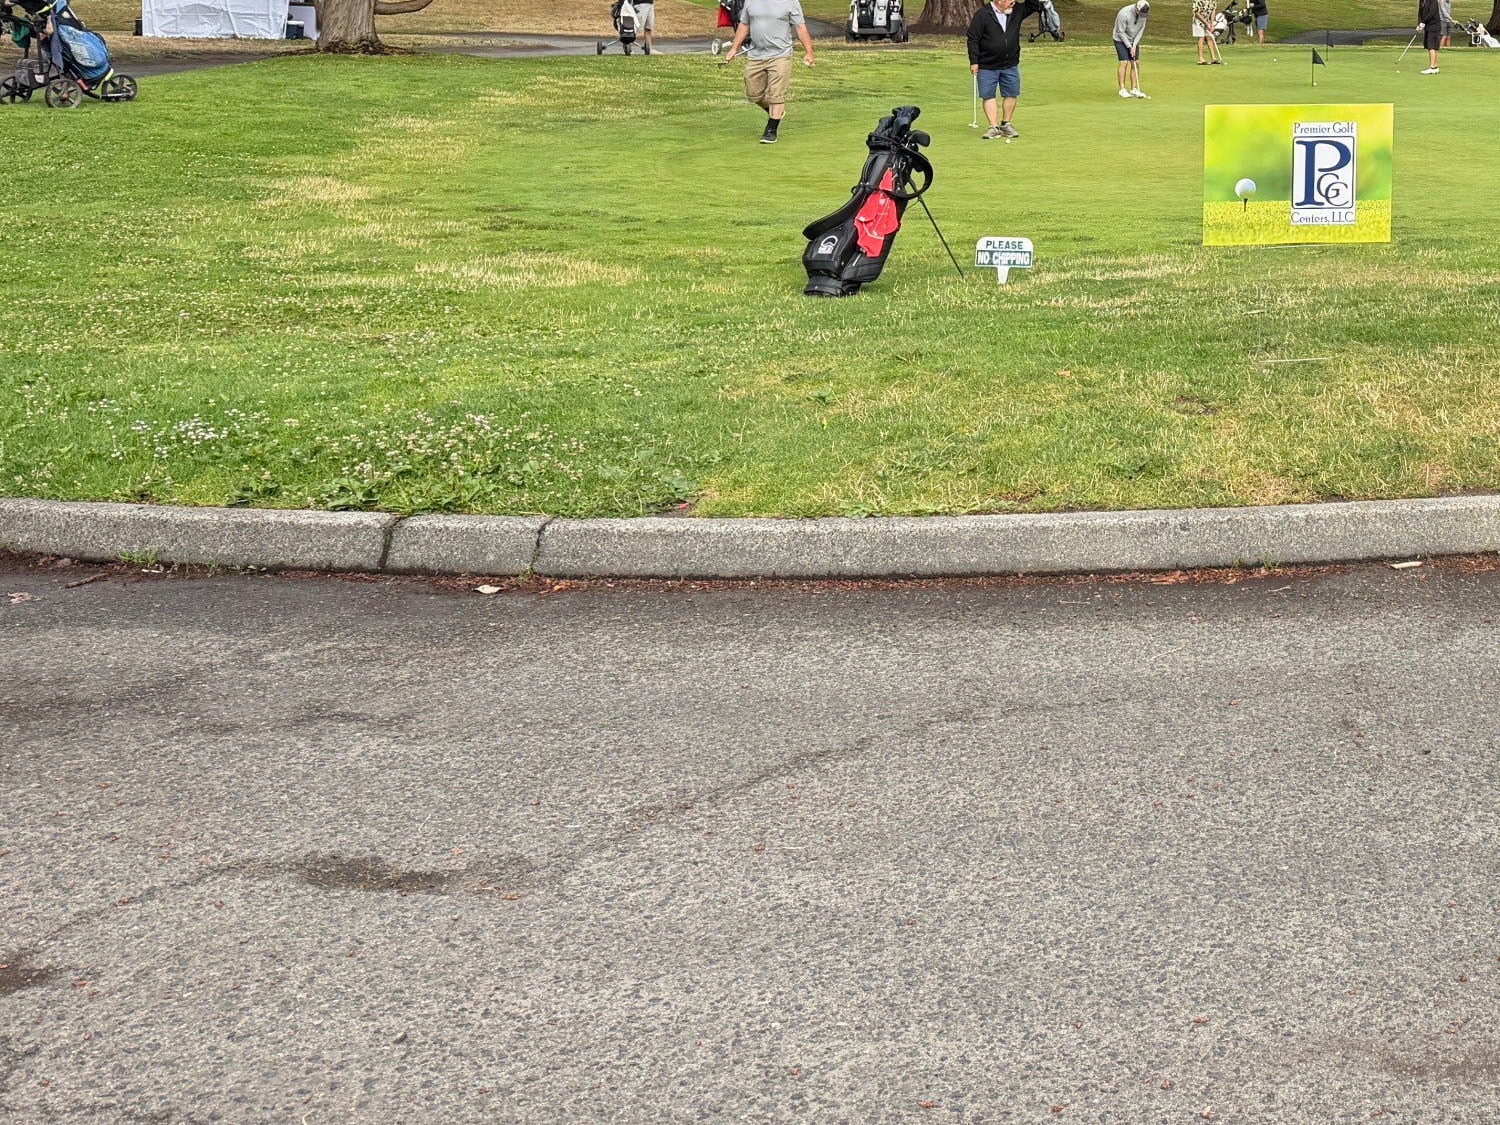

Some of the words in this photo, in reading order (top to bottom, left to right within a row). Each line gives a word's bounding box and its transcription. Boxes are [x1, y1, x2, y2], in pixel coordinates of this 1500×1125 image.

[1294, 122, 1331, 134] Premier
[1332, 122, 1354, 134] Golf
[1291, 211, 1330, 224] Centers,
[985, 241, 1023, 249] PLEASE
[977, 251, 990, 264] NO
[992, 252, 1030, 265] CHIPPING
